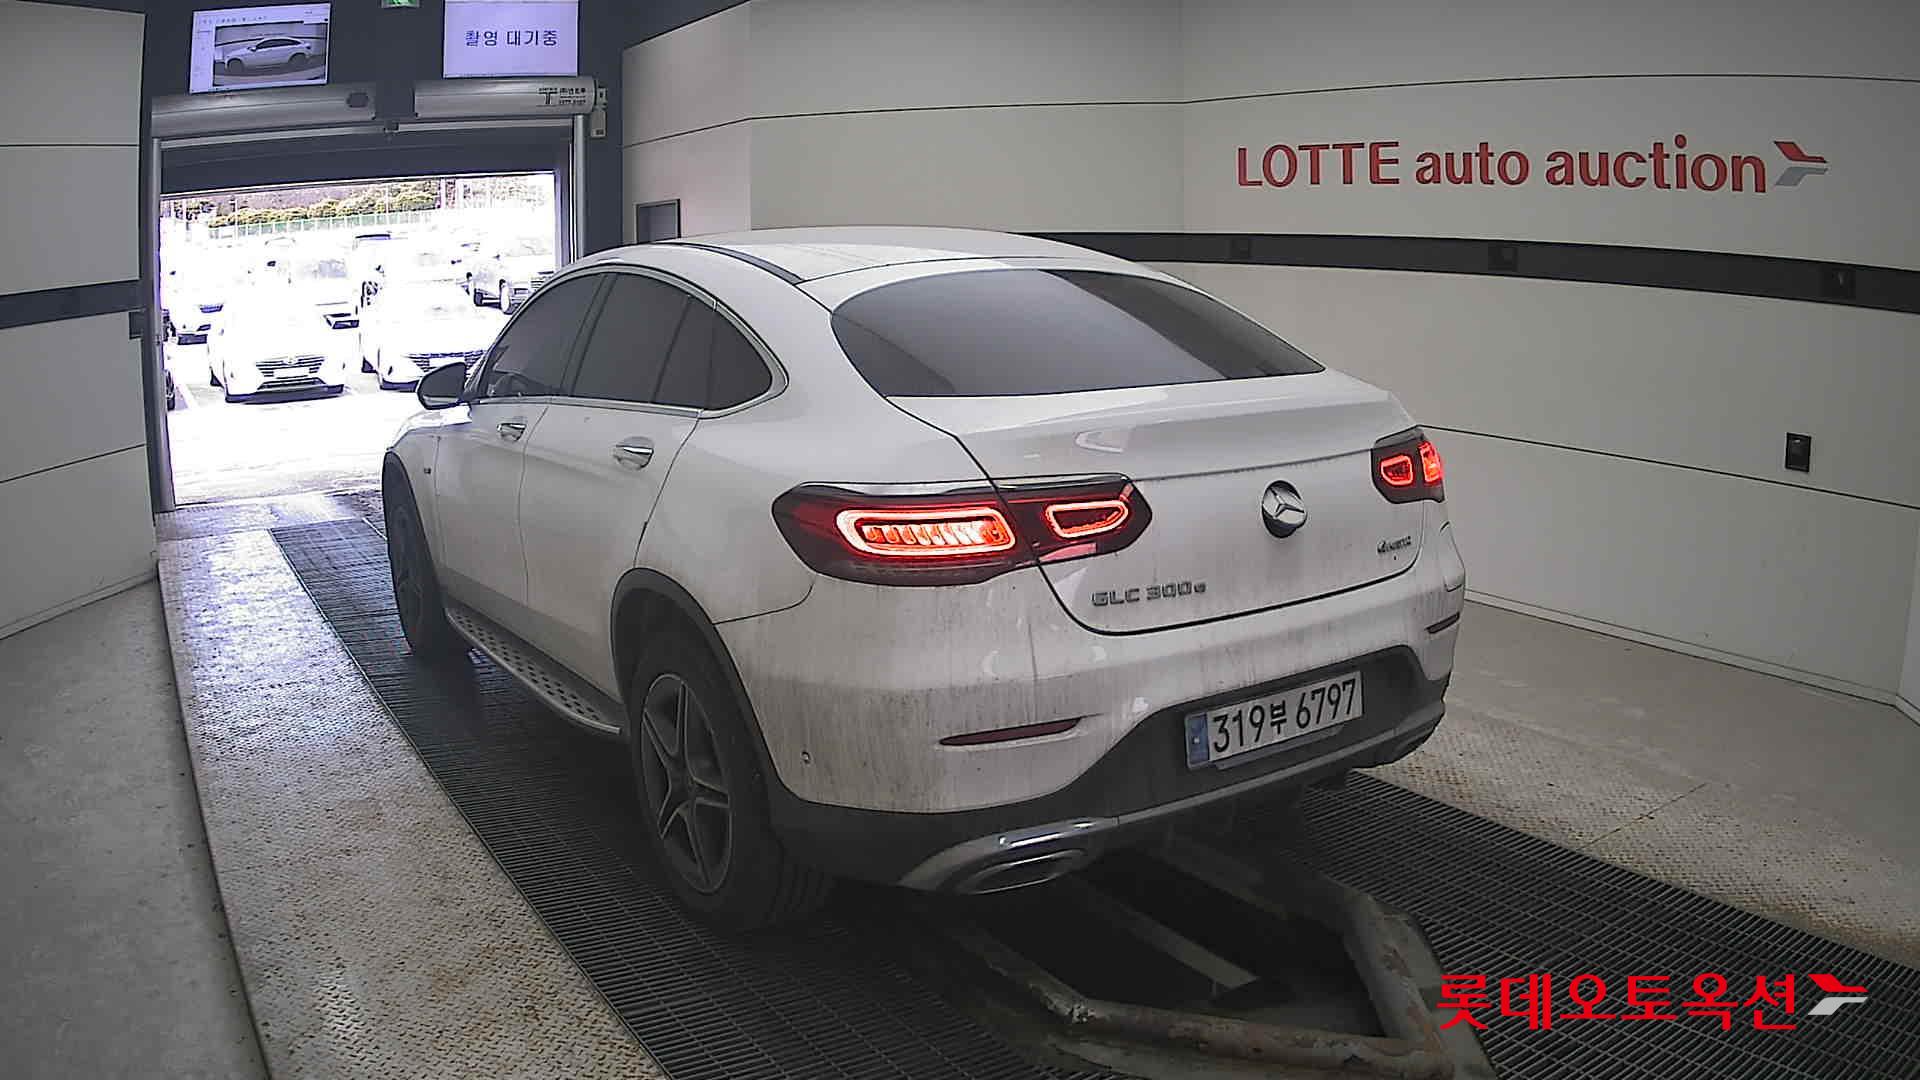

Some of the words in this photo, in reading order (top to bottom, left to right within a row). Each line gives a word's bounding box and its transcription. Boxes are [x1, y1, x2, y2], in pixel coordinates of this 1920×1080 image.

[465, 29, 498, 47] 촬영
[506, 29, 558, 47] 대기중
[1237, 141, 1399, 187] LOTTE
[1415, 141, 1530, 186] auto
[1545, 134, 1766, 193] auction
[1091, 588, 1140, 606] GLC
[1213, 700, 1287, 753] 319부
[1296, 678, 1356, 729] 6797
